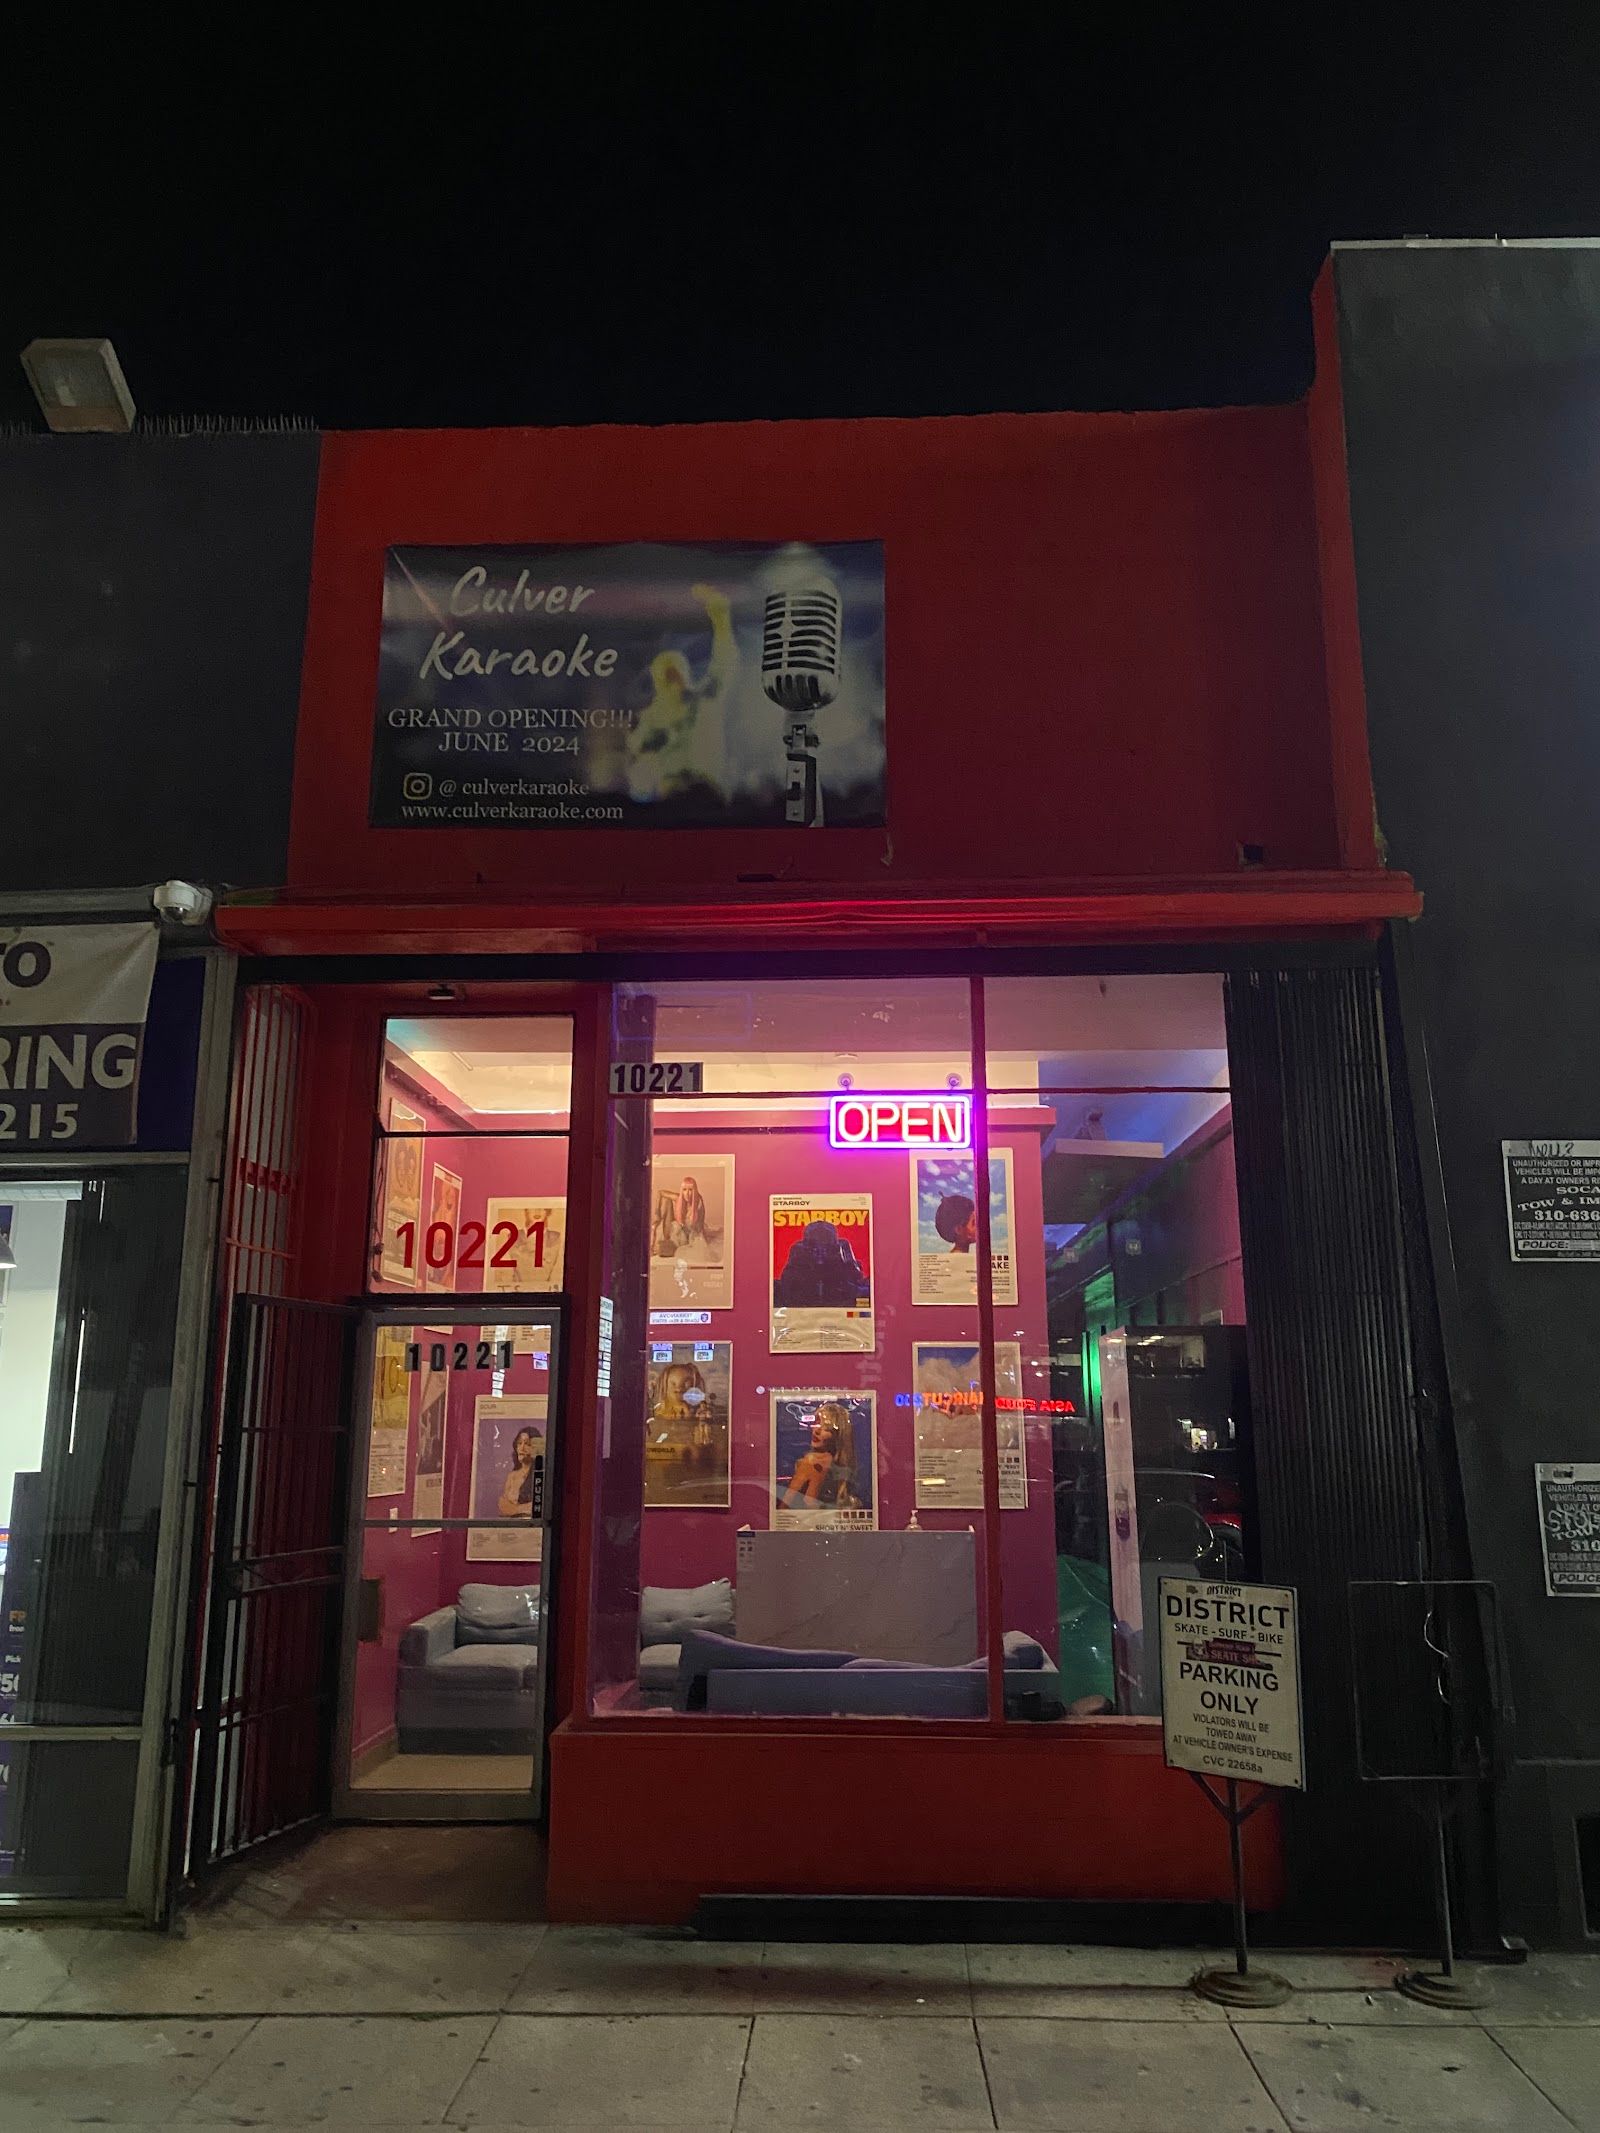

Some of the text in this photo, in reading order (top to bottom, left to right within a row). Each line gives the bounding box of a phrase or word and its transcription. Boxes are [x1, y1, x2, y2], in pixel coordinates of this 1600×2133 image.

[451, 566, 595, 617] Culver
[420, 631, 619, 681] Karaoke
[388, 708, 633, 729] GRAND OPENING!!!
[438, 732, 580, 756] JUNE 2024
[462, 778, 591, 796] culverkaraoke
[401, 802, 624, 820] www.culverkaraoke.com
[0, 941, 52, 988] O
[614, 1063, 703, 1093] 10221
[838, 1102, 963, 1142] OPEN
[1513, 1160, 1570, 1168] UNAUTHORIZED
[1571, 1160, 1582, 1168] OR
[1515, 1168, 1552, 1176] VEHICLES
[1553, 1168, 1572, 1176] WILL
[1573, 1168, 1584, 1176] BE
[1556, 1177, 1590, 1185] OWNERS
[1517, 1198, 1555, 1211] TOW
[1561, 1197, 1574, 1206] &
[773, 1210, 869, 1227] STARBOY
[1534, 1210, 1600, 1221] 310-636
[397, 1221, 546, 1269] 10221
[1522, 1241, 1569, 1249] POLICE:
[408, 1341, 513, 1371] 10221
[534, 1477, 542, 1513] PUSH
[1548, 1494, 1587, 1502] VEHICLES
[1166, 1595, 1290, 1629] DISTRICT
[1174, 1623, 1208, 1635] SKATE
[1218, 1628, 1247, 1639] SURF
[1258, 1632, 1283, 1645] BIKE
[1180, 1661, 1279, 1691] PARKING
[1200, 1690, 1259, 1715] ONLY
[1192, 1713, 1270, 1733] VIOLATORS WILL BE
[1206, 1727, 1257, 1743] TOWED AWAY
[1173, 1735, 1293, 1762] AT VEHICLE OWNER'S EXPENSE
[1203, 1755, 1263, 1773] CVC 22658a
